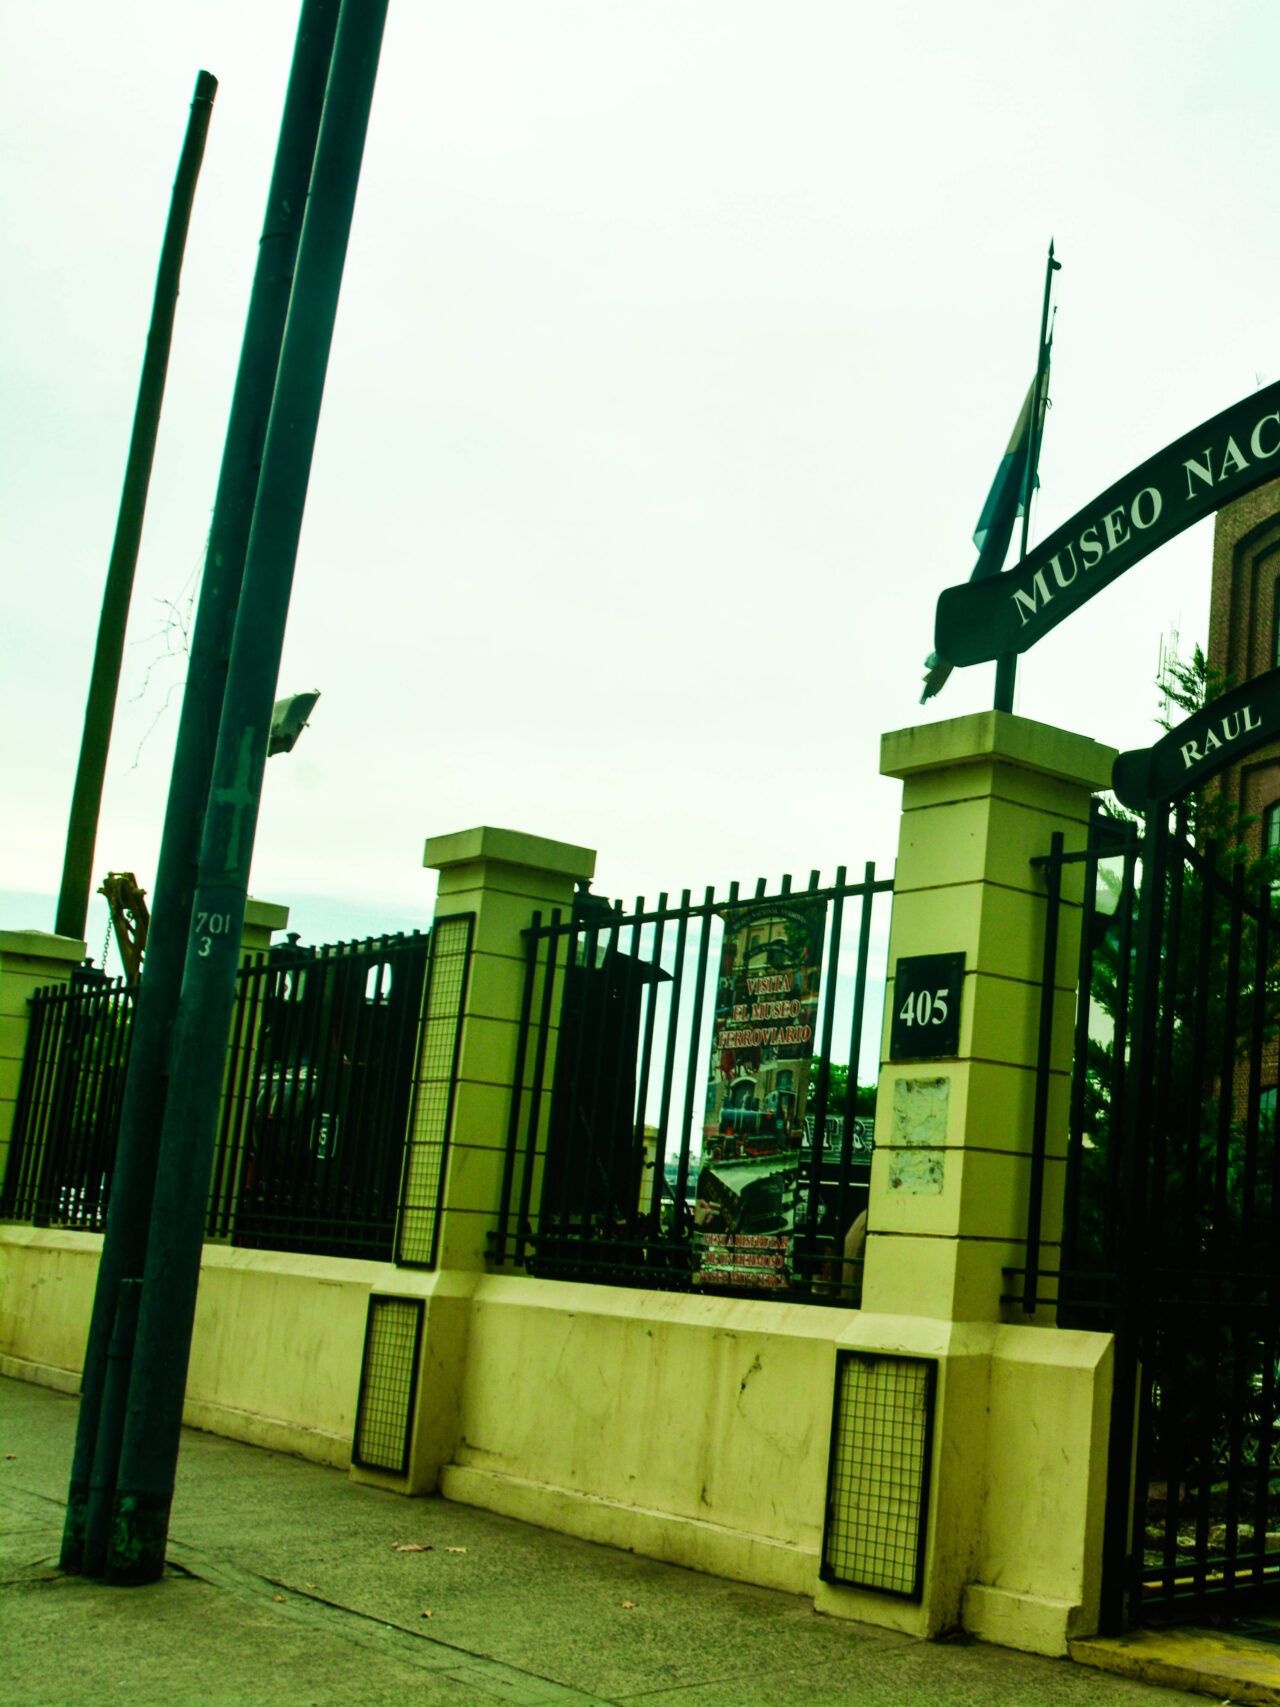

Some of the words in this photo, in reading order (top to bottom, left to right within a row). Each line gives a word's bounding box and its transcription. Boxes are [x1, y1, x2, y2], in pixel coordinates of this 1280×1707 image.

[1011, 487, 1163, 628] MUSEO
[1179, 704, 1263, 770] RAUL
[194, 911, 232, 934] 701
[197, 936, 213, 958] 3
[750, 999, 801, 1021] MUSEO
[899, 988, 949, 1027] 405
[717, 1024, 812, 1050] FERROVIARIO
